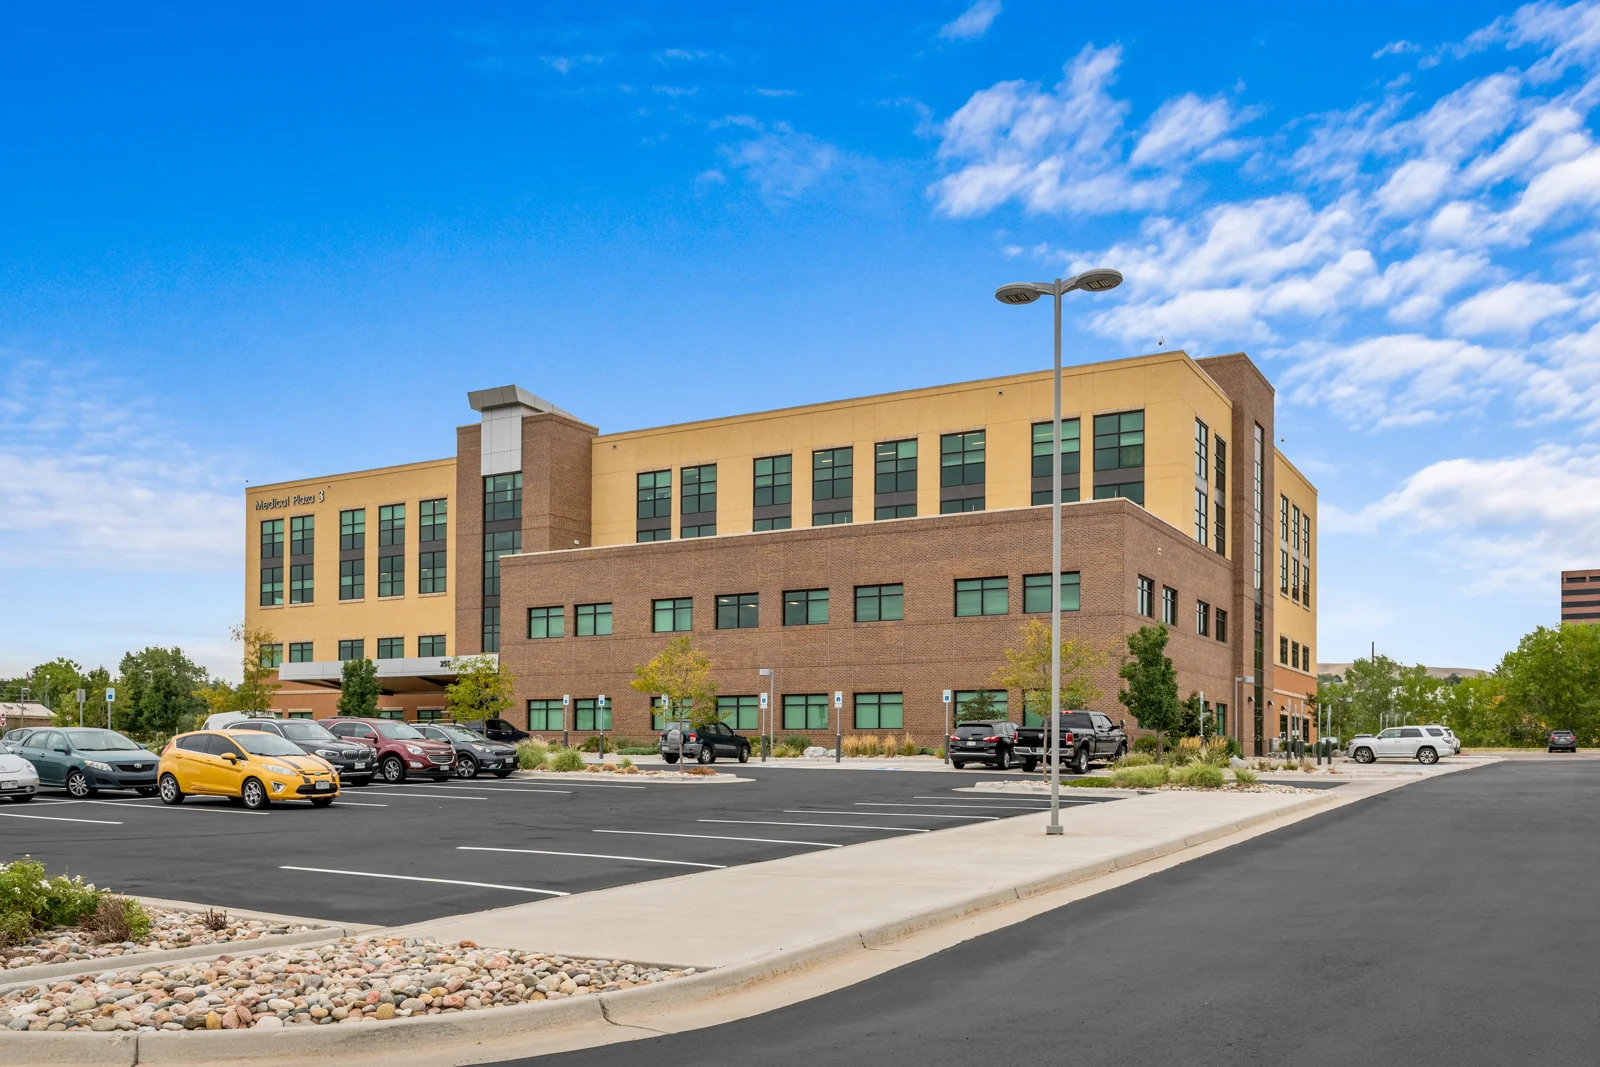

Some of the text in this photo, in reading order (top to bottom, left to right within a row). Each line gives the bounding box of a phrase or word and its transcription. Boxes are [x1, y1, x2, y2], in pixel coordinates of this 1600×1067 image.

[256, 489, 324, 510] Medical Plaza 3
